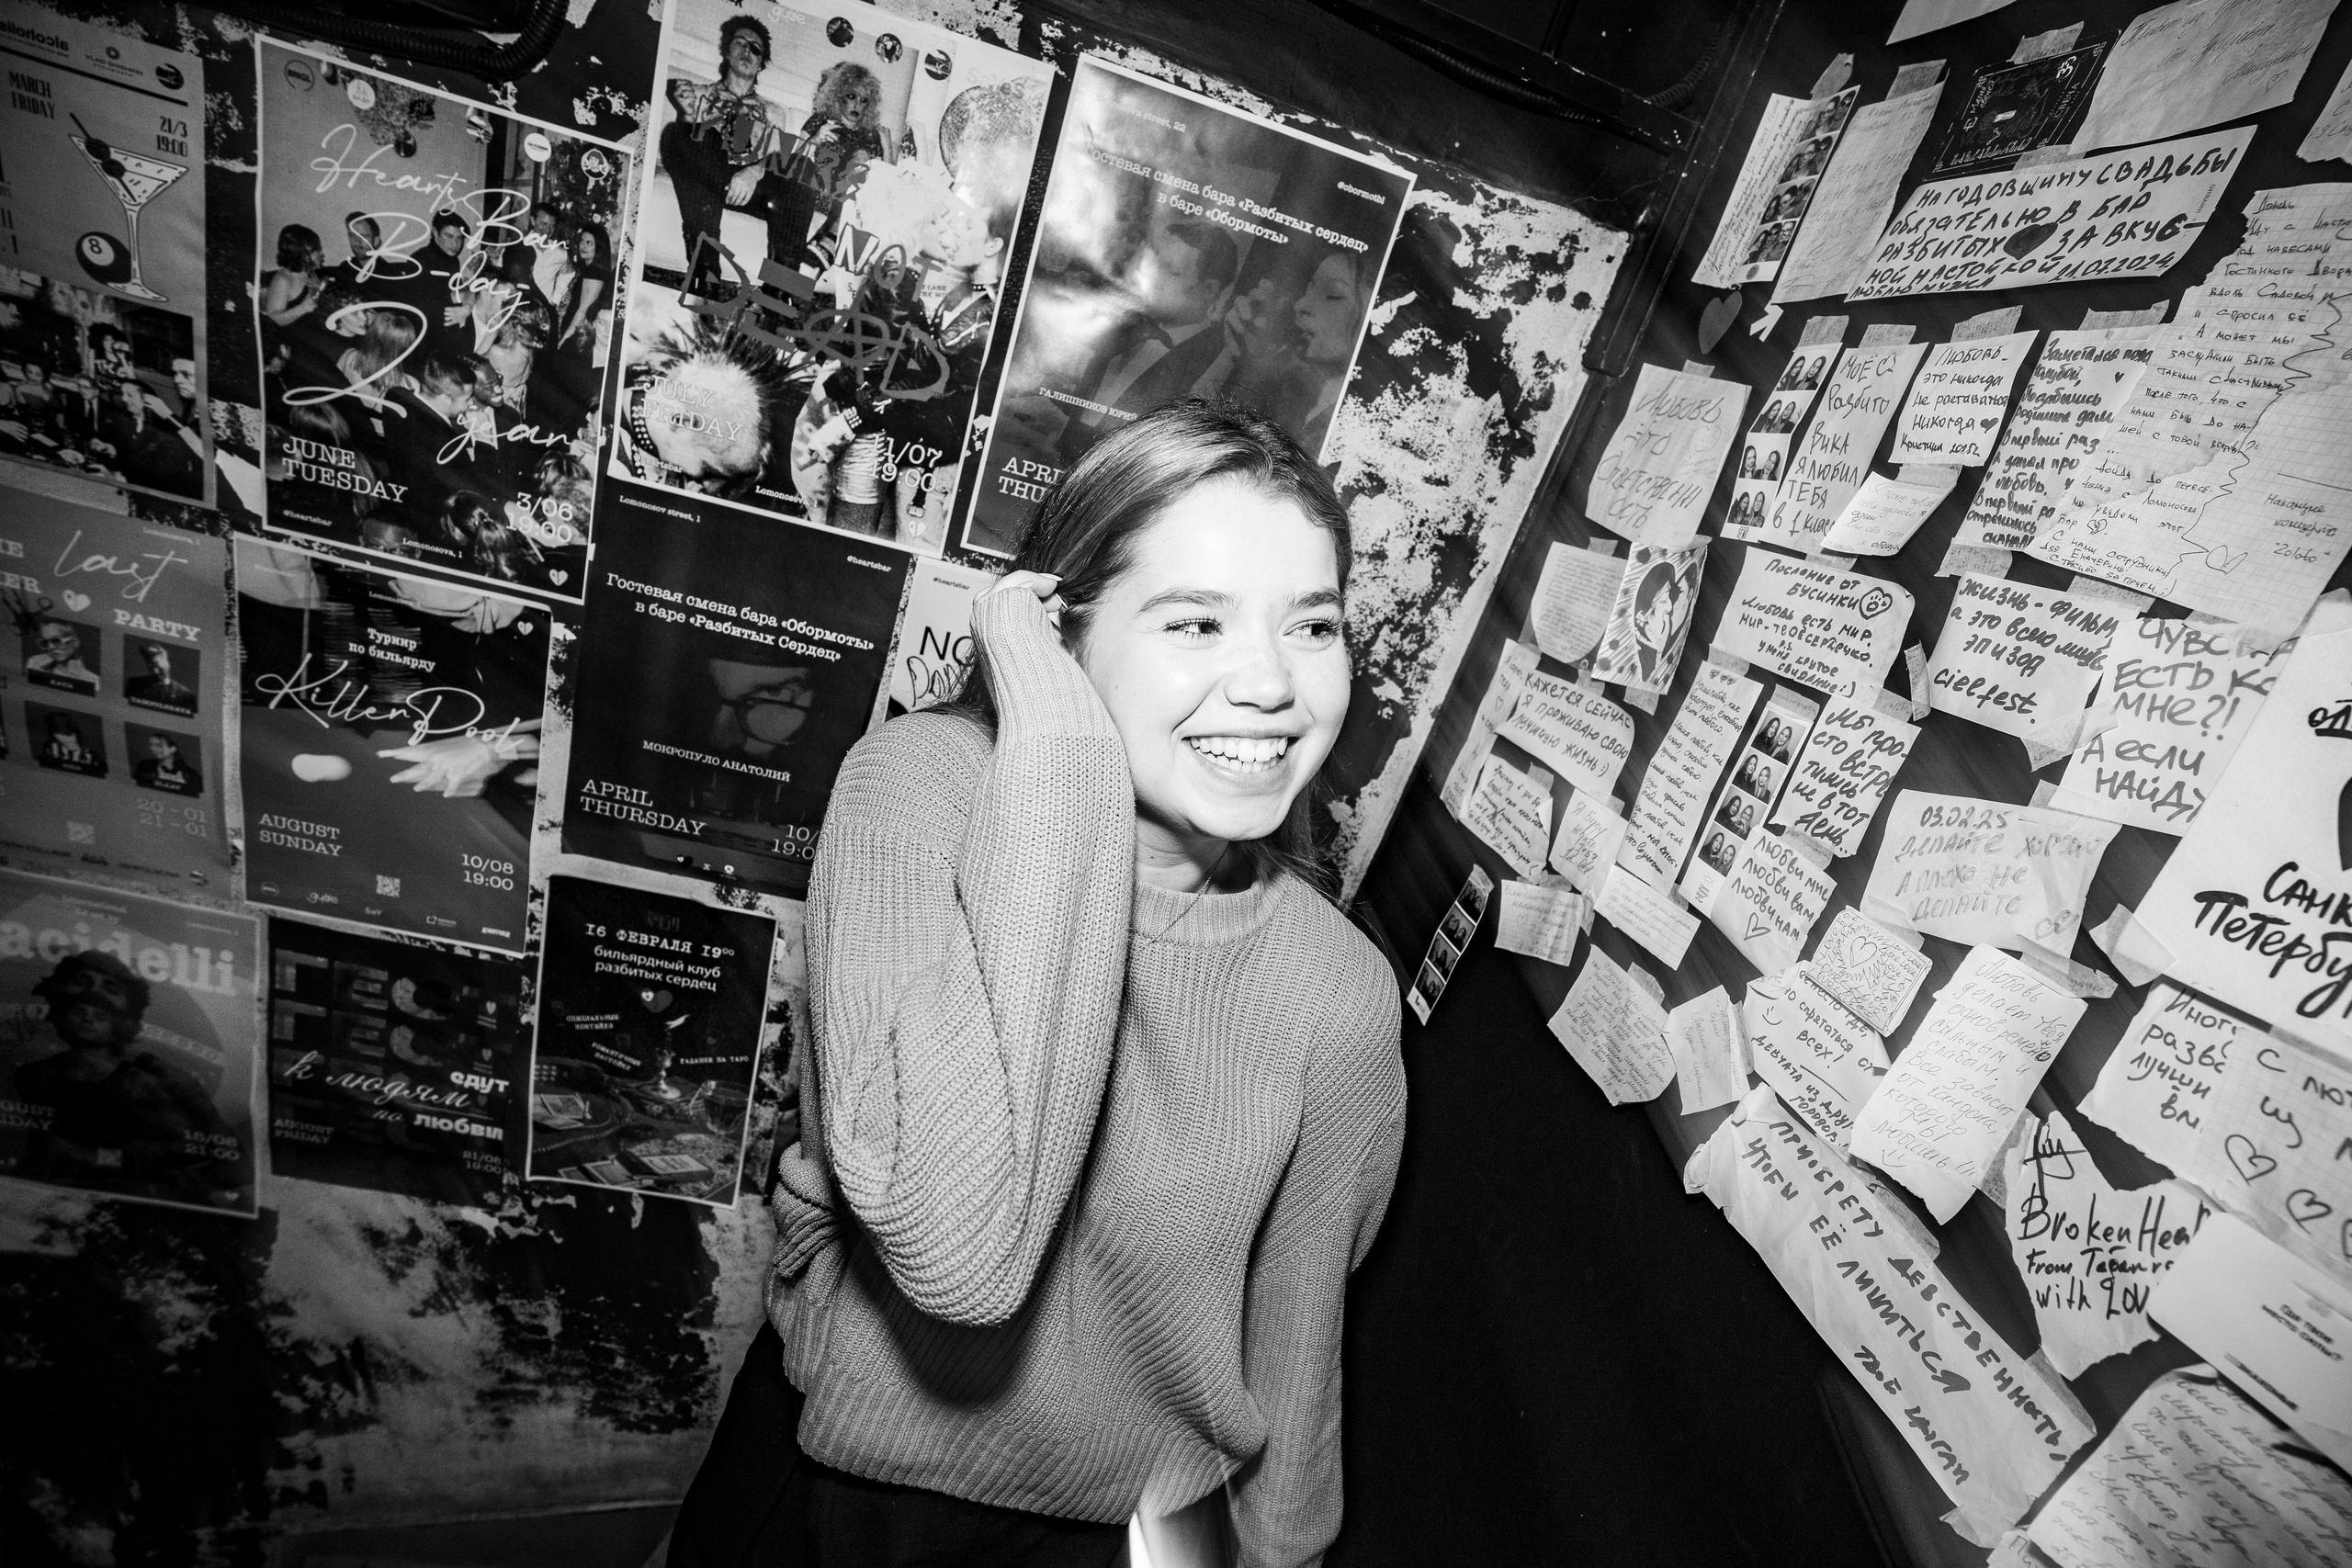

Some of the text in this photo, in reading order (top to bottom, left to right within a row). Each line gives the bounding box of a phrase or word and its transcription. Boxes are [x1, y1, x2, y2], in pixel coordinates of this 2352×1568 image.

[9, 70, 51, 98] MARCH
[12, 93, 55, 119] FRIDAY
[159, 116, 188, 138] 21/3
[1173, 121, 1187, 133] 22
[156, 135, 188, 157] 19:00
[1086, 145, 1369, 254] Гостевая смена бара «Разбитых сердец»
[2087, 191, 2151, 220] БАР
[460, 188, 569, 249] Bar
[1158, 191, 1289, 244] в баре «Обормоты»
[87, 235, 102, 254] 8
[641, 374, 717, 409] JULY
[1039, 387, 1138, 422] ГАЛИШНИКОВ ЮРИЙ
[641, 398, 744, 442] FRIDAY
[282, 435, 356, 469] JUNE
[872, 433, 942, 466] 11/07
[282, 457, 408, 503] TUESDAY
[868, 458, 938, 493] 19:00
[515, 492, 574, 521] 3/06
[618, 495, 695, 522] Lomonosov street,
[505, 513, 572, 544] 19:00
[402, 536, 457, 558] Lomonosova,
[846, 554, 892, 573] @heartsbar
[113, 608, 201, 641] PARTY
[606, 572, 875, 652] Гостевая смена бара «Обормоты»
[367, 626, 417, 650] Турнир
[635, 602, 842, 661] в баре «Разбитых Сердец»
[348, 641, 436, 672] по бильярду
[254, 652, 525, 746] Killer Pool
[642, 739, 791, 783] МОКРОПУЛО АНАТОЛИЙ
[581, 779, 654, 807] APRIL
[259, 812, 341, 840] AUGUST
[580, 795, 707, 837] THURSDAY
[258, 829, 343, 856] SUNDAY
[460, 853, 514, 874] 10/08
[463, 871, 514, 891] 19:00
[585, 923, 693, 953] 16 ФЕВРАЛЯ
[594, 944, 721, 978] бильярдный клуб
[594, 960, 717, 993] разбитых сердец
[450, 1071, 509, 1093] едут
[413, 1113, 503, 1141] любви
